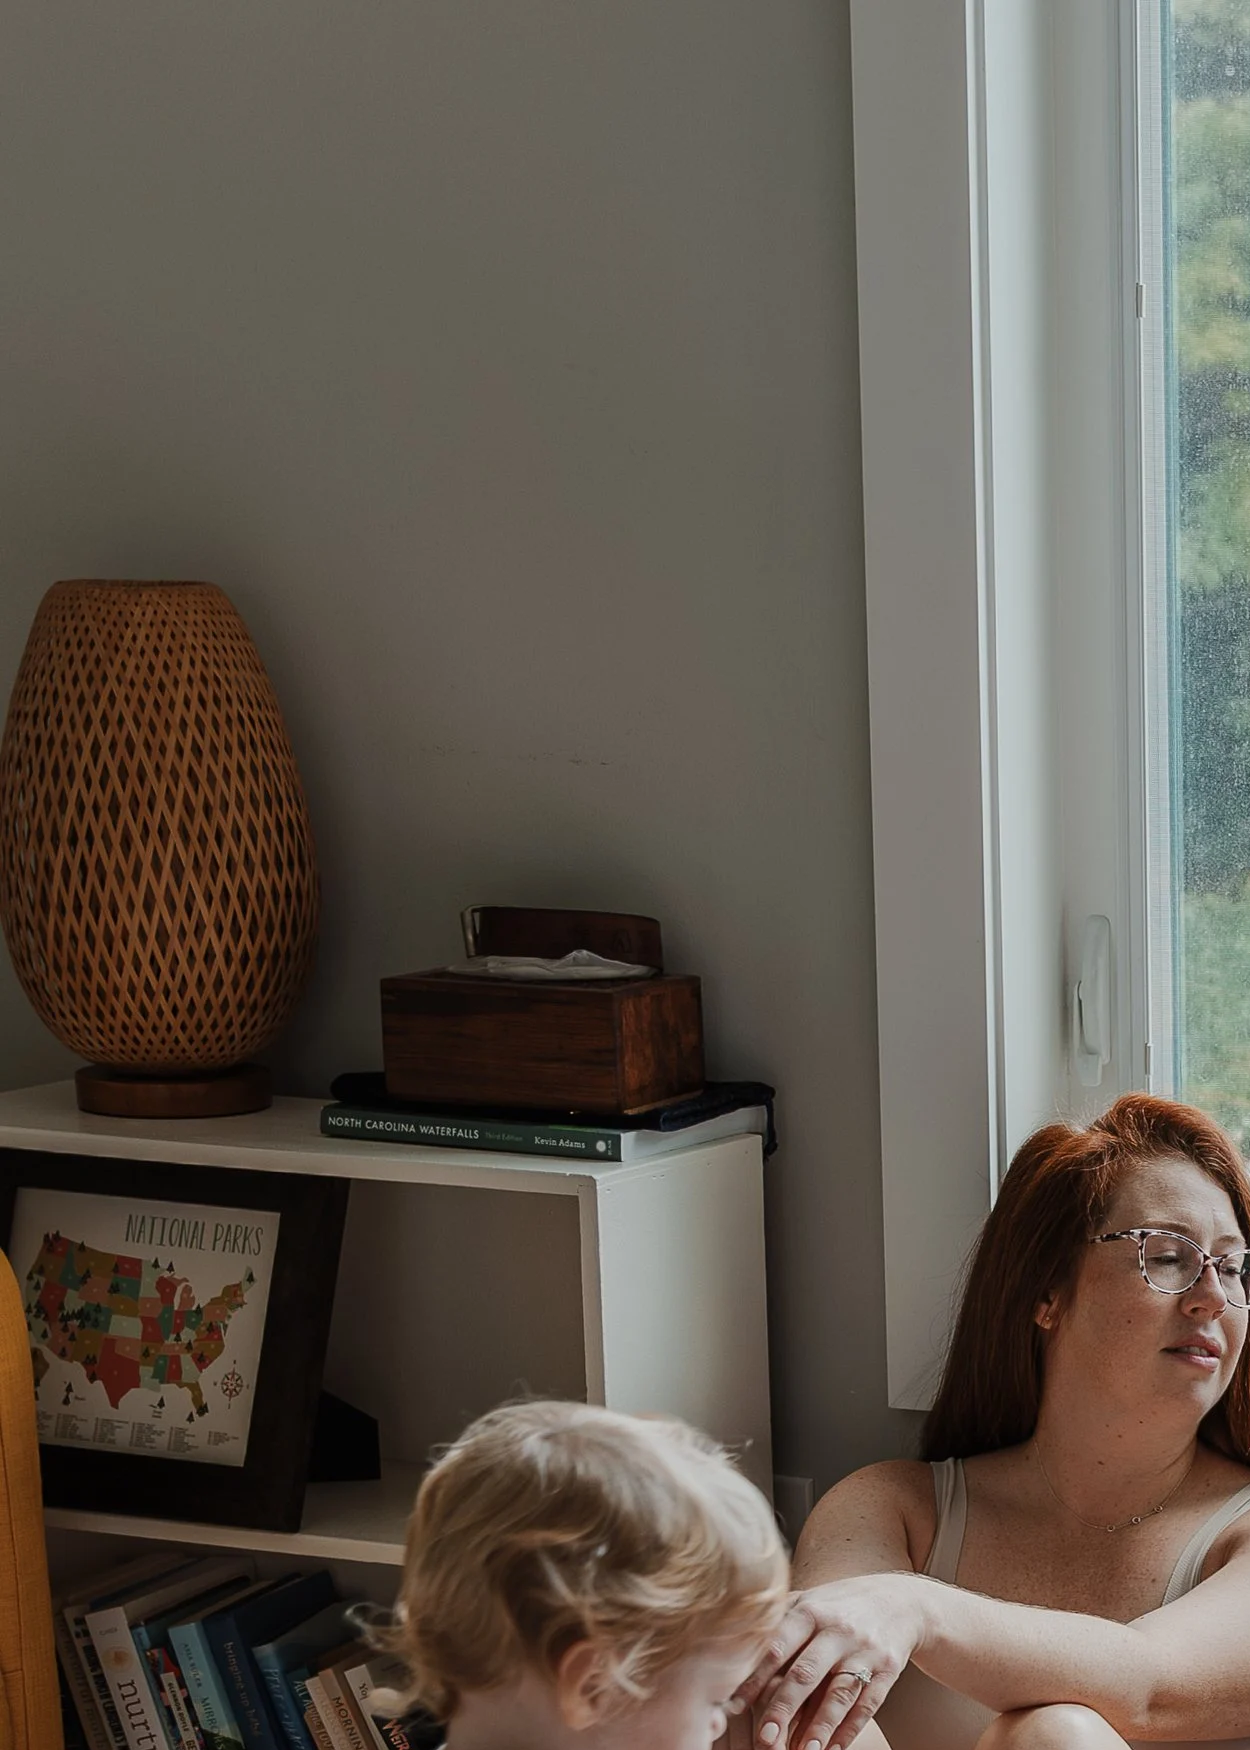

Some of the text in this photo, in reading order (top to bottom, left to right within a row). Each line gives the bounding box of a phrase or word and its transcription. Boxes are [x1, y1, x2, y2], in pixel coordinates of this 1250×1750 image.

[328, 1115, 480, 1140] NORTH CAROLINA WATERFALLS
[534, 1135, 586, 1149] Kevin Adams
[125, 1213, 264, 1256] NATIONAL PARKS
[222, 1640, 247, 1692] bringing
[238, 1692, 249, 1708] up
[292, 1679, 308, 1697] ALL
[167, 1682, 182, 1713] GLENNON
[177, 1711, 190, 1733] DOYLE
[200, 1696, 225, 1750] MIRRORS
